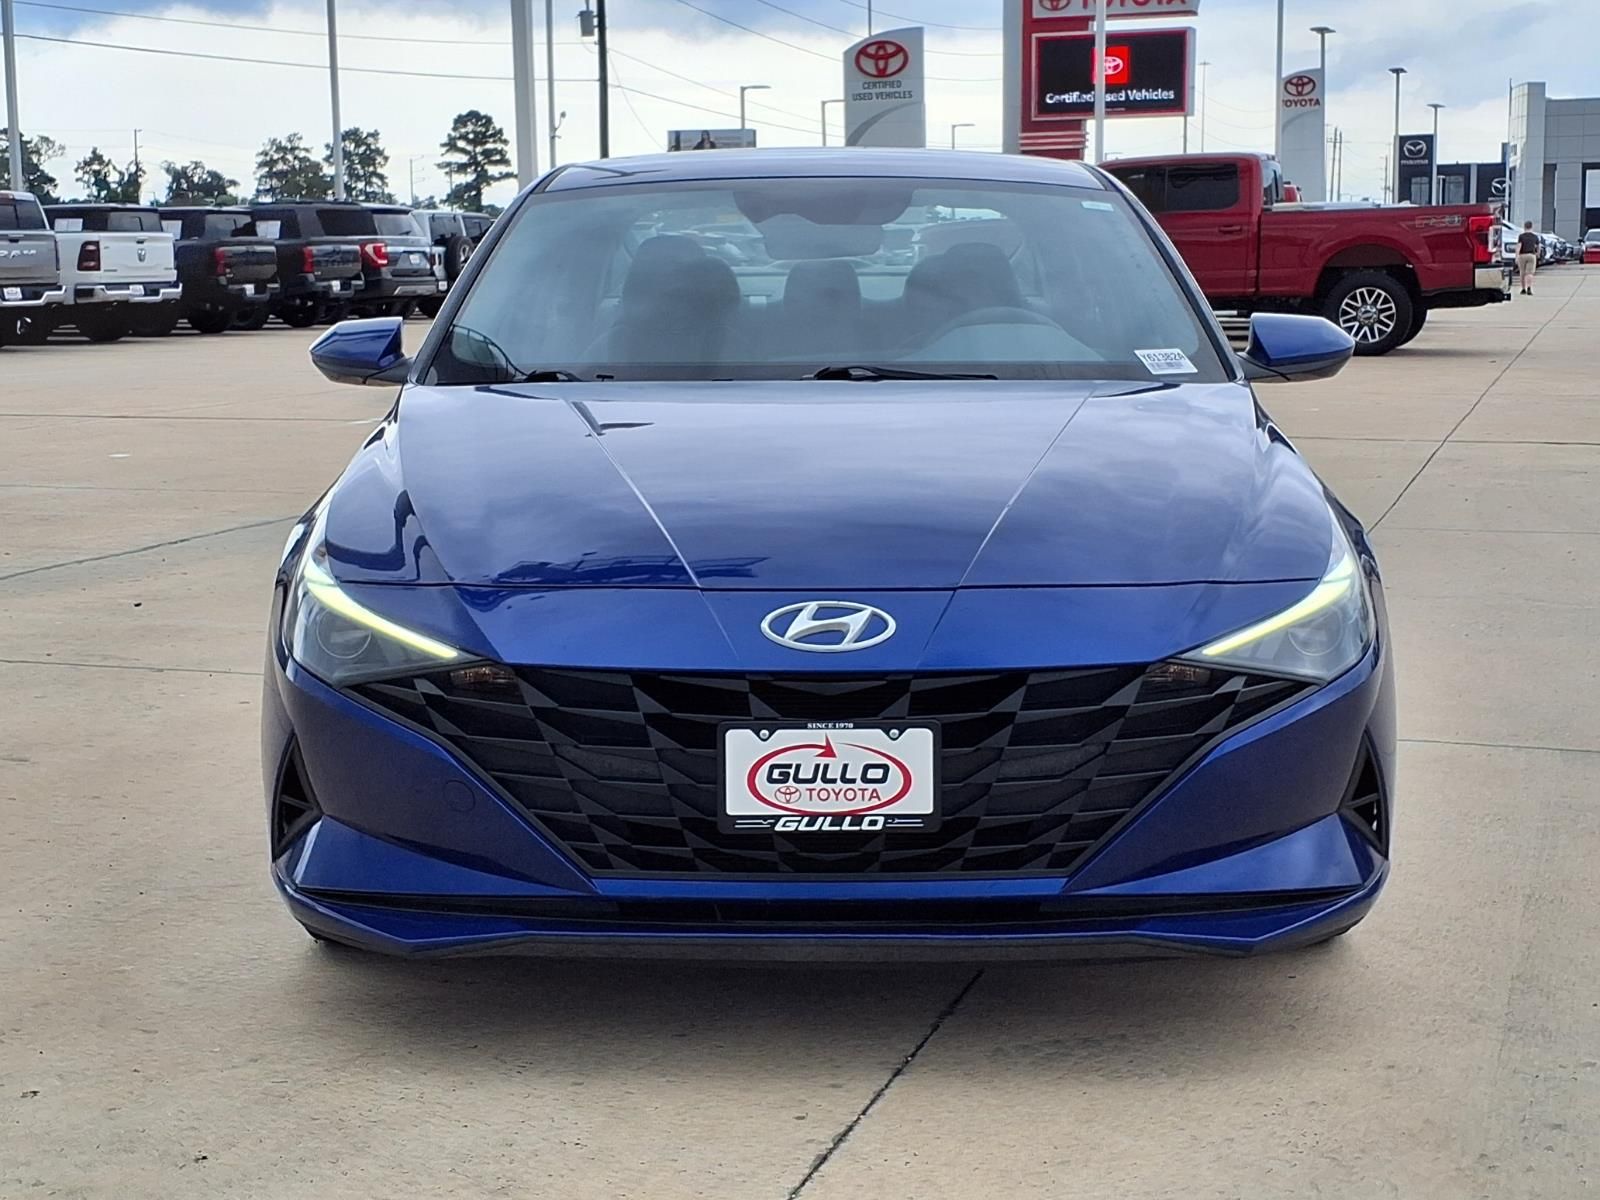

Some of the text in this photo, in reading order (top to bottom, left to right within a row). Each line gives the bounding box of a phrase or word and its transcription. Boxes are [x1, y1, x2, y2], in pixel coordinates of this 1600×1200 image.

[862, 80, 902, 90] CERTIFIED
[852, 90, 913, 102] USED VEHICLES
[1045, 91, 1096, 104] Certified
[1126, 88, 1175, 101] Vehicles
[766, 763, 890, 785] GULLO
[806, 787, 881, 802] TOYOTA
[774, 816, 885, 831] GULLO
